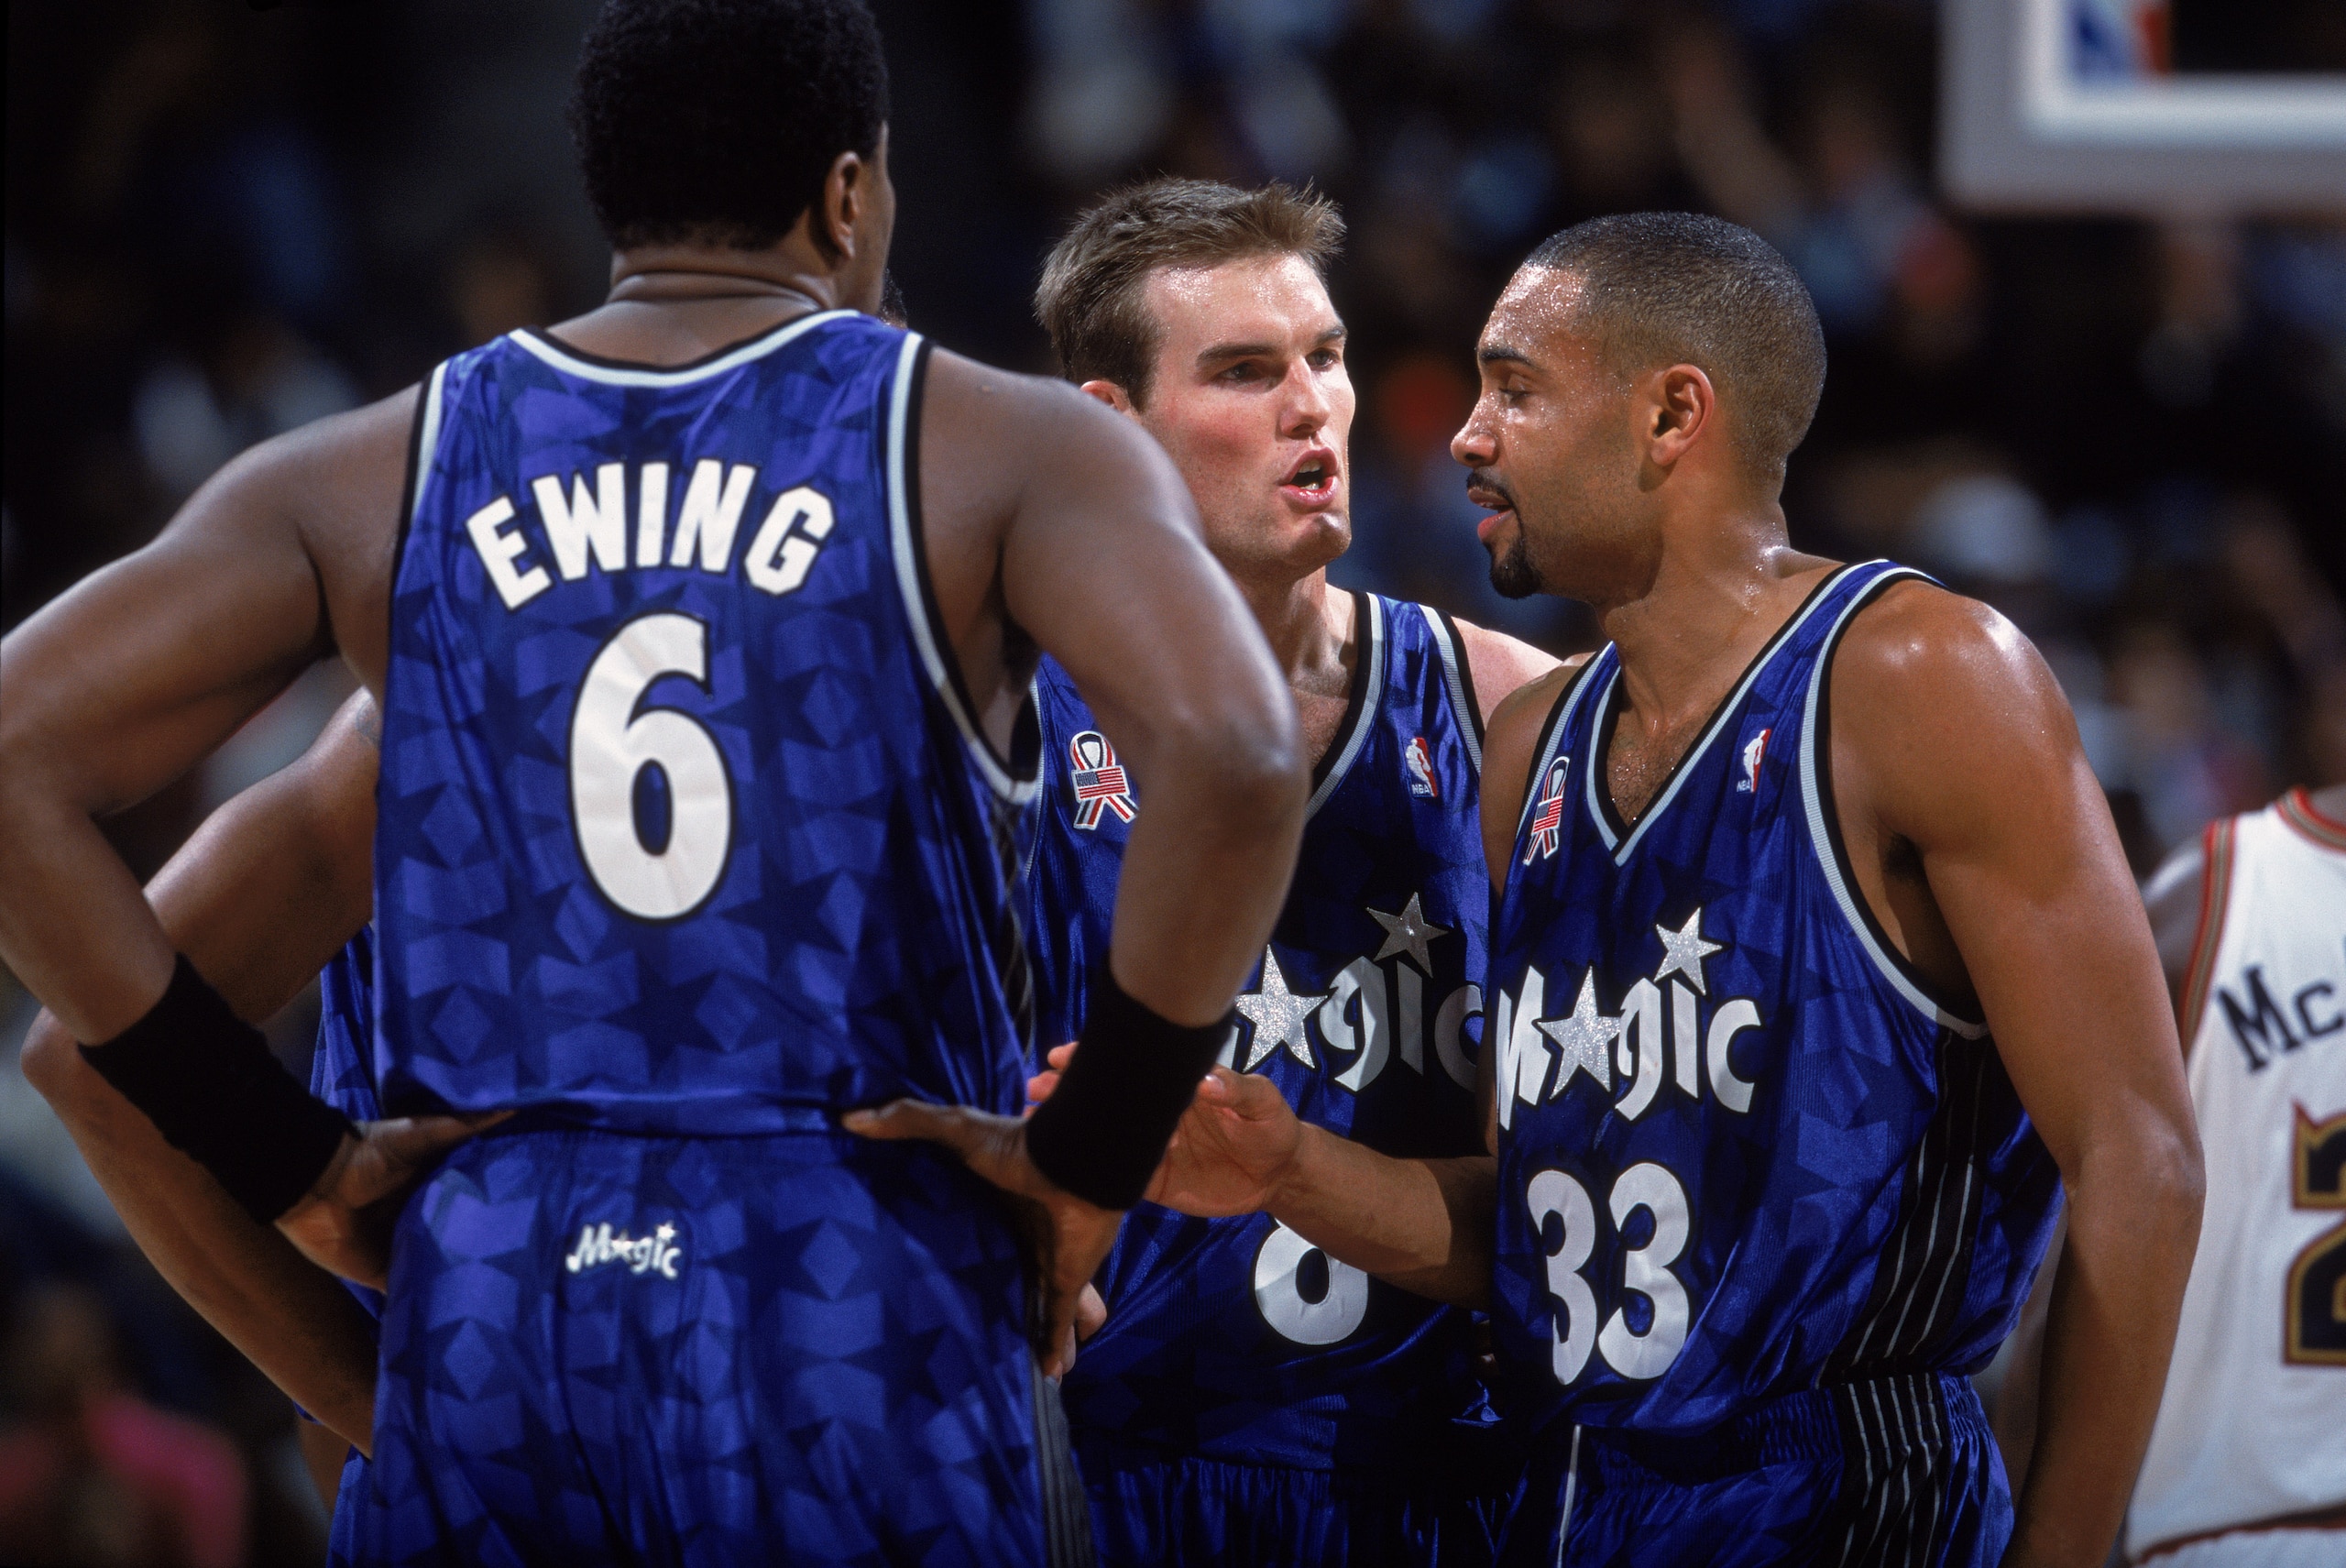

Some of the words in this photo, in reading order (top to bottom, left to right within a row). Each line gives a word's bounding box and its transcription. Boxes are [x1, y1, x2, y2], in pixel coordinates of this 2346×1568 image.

[466, 458, 835, 611] EWING
[570, 612, 730, 919] 6
[1412, 783, 1431, 795] NBA
[1737, 778, 1751, 793] NBA
[1214, 893, 1483, 1092] agic
[1496, 907, 1761, 1132] Magic
[2218, 938, 2346, 1072] Mc
[565, 1220, 682, 1279] Magic
[1527, 1162, 1691, 1386] 33
